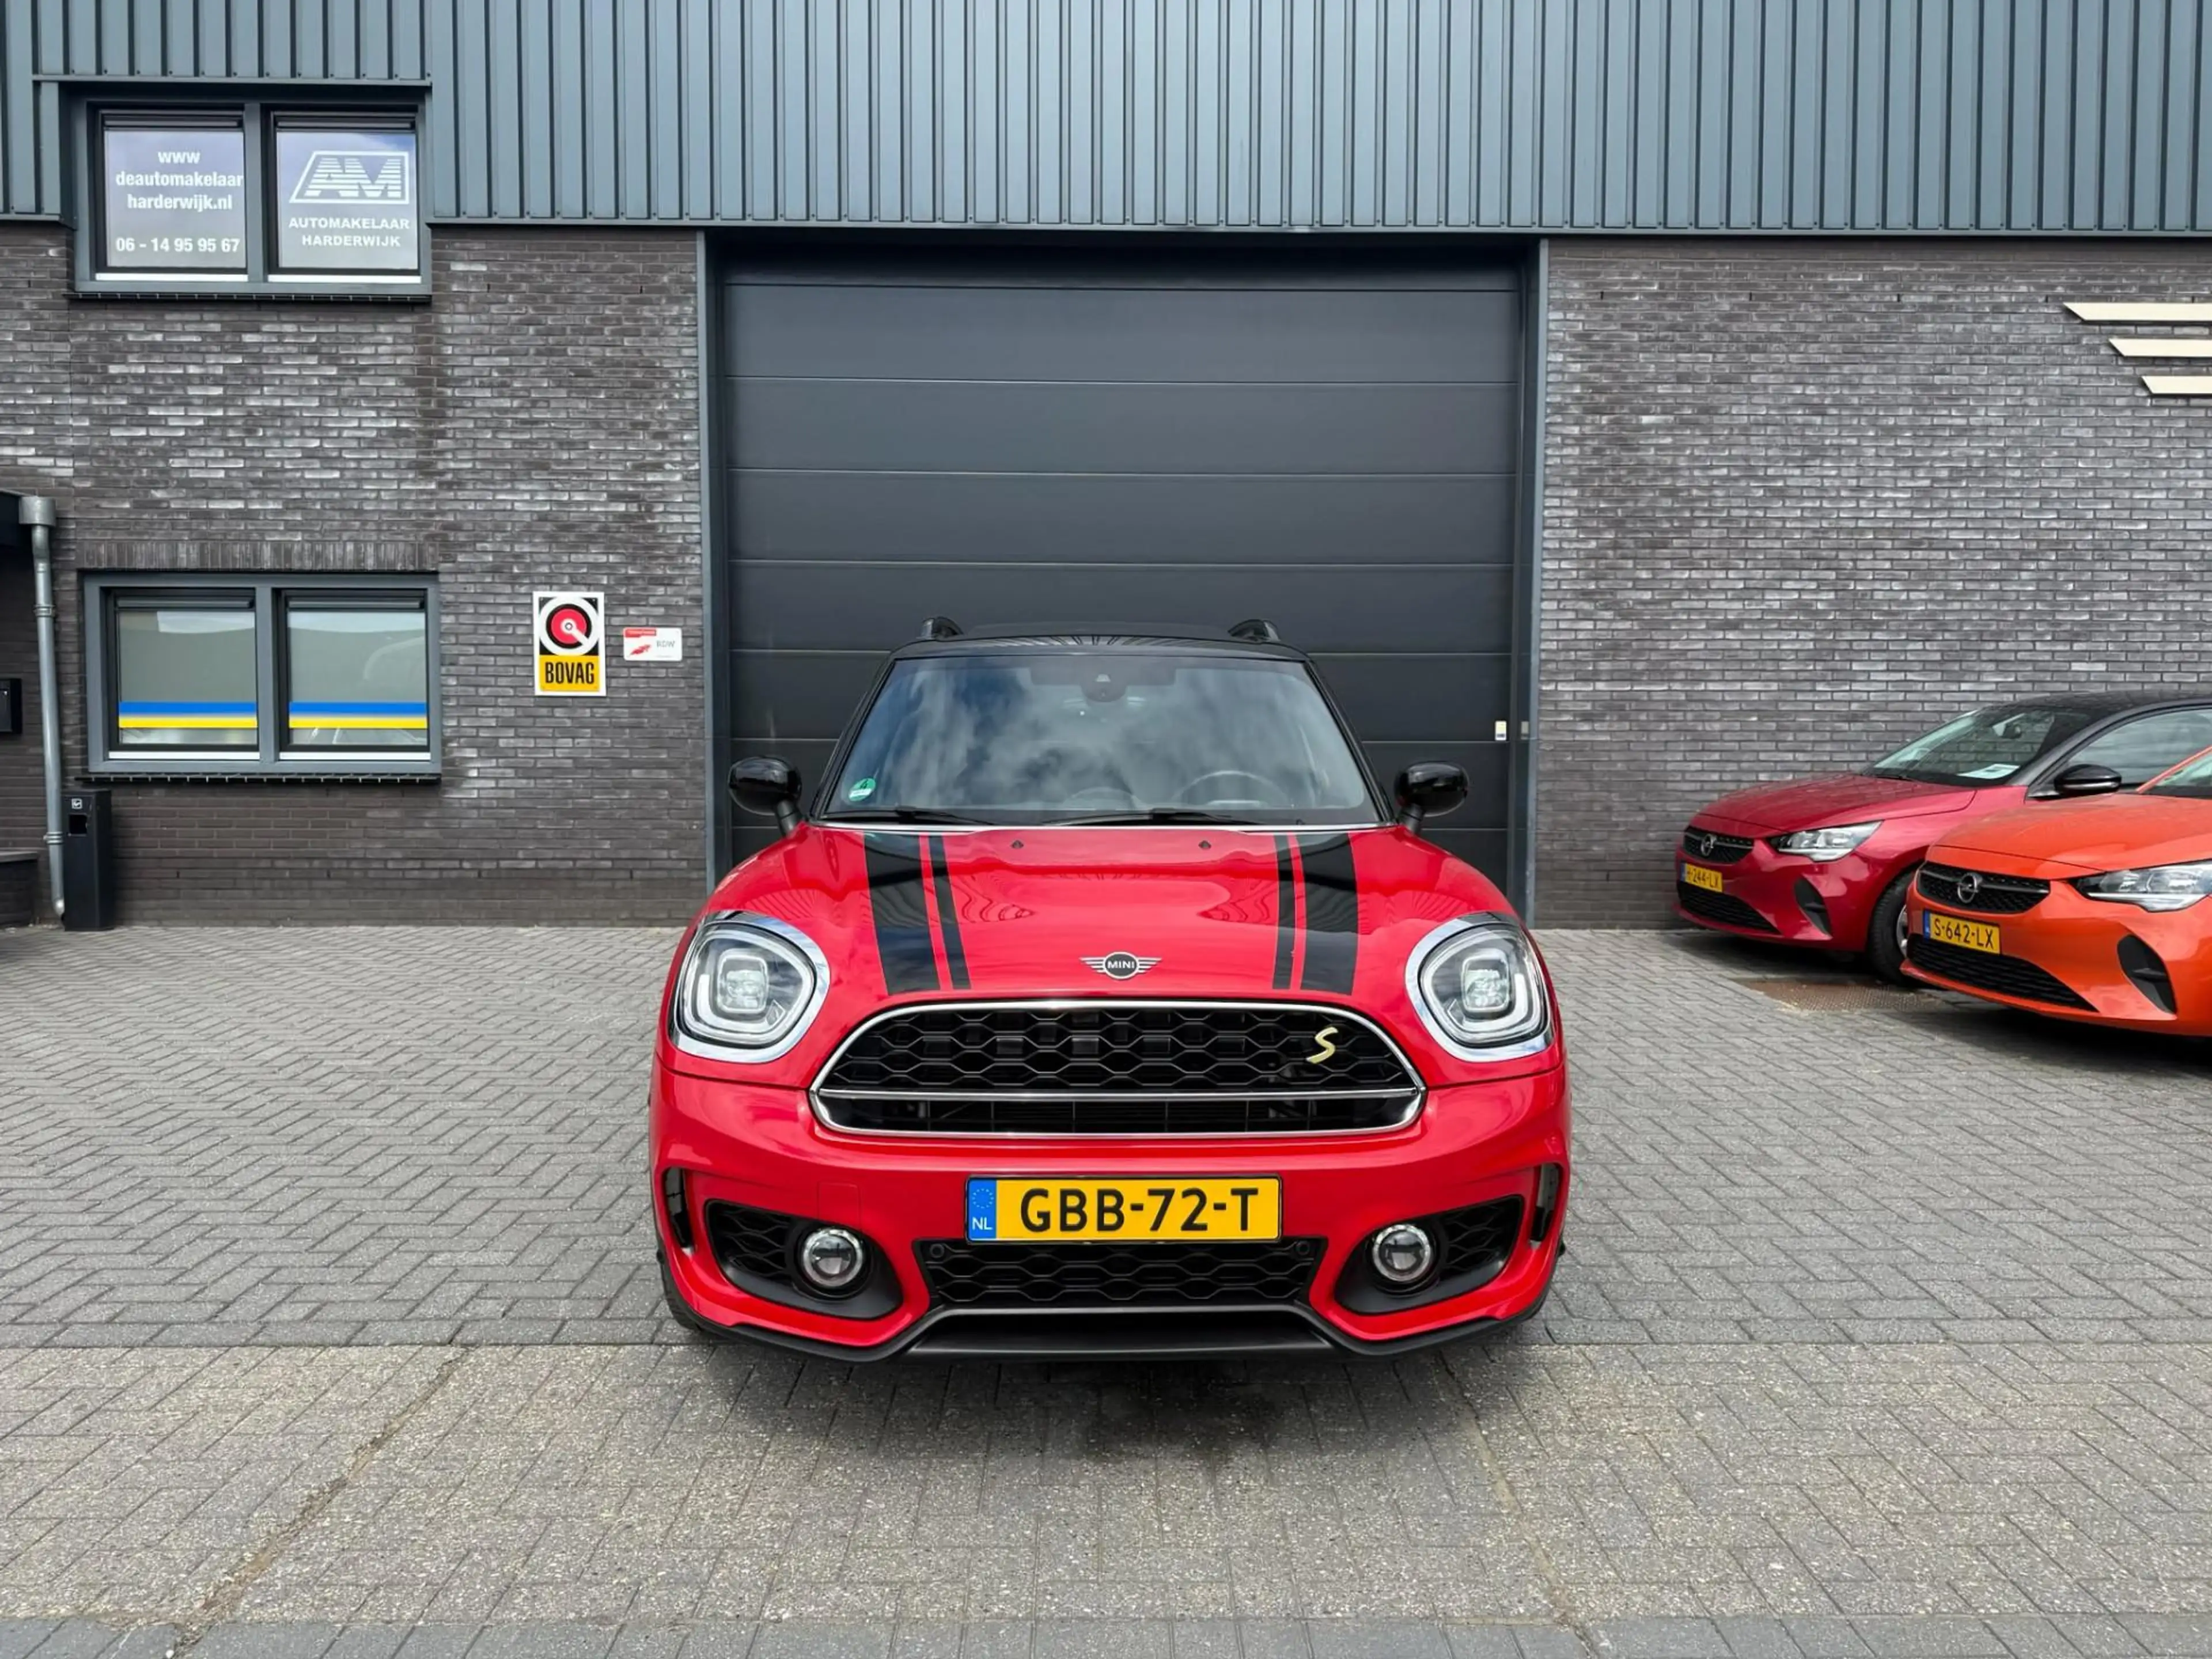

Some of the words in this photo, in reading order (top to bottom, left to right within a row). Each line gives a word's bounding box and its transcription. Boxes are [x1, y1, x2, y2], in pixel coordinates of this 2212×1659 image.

[157, 151, 200, 165] www
[116, 170, 244, 187] deautomakelaar
[304, 157, 402, 198] AM
[127, 193, 232, 213] harderwijk.nl
[289, 217, 410, 229] AUTOMAKELAAR
[116, 237, 135, 252] 06
[151, 237, 169, 252] 14
[174, 238, 194, 252] 95
[198, 238, 217, 252] 95
[221, 238, 240, 252] 67
[302, 235, 401, 247] HARDERWIJK
[545, 661, 594, 684] BOVAG
[1934, 918, 1994, 949] S-642-LX
[1306, 1027, 1338, 1064] S
[972, 1217, 993, 1230] NL
[1021, 1188, 1259, 1233] GBB-72-T
